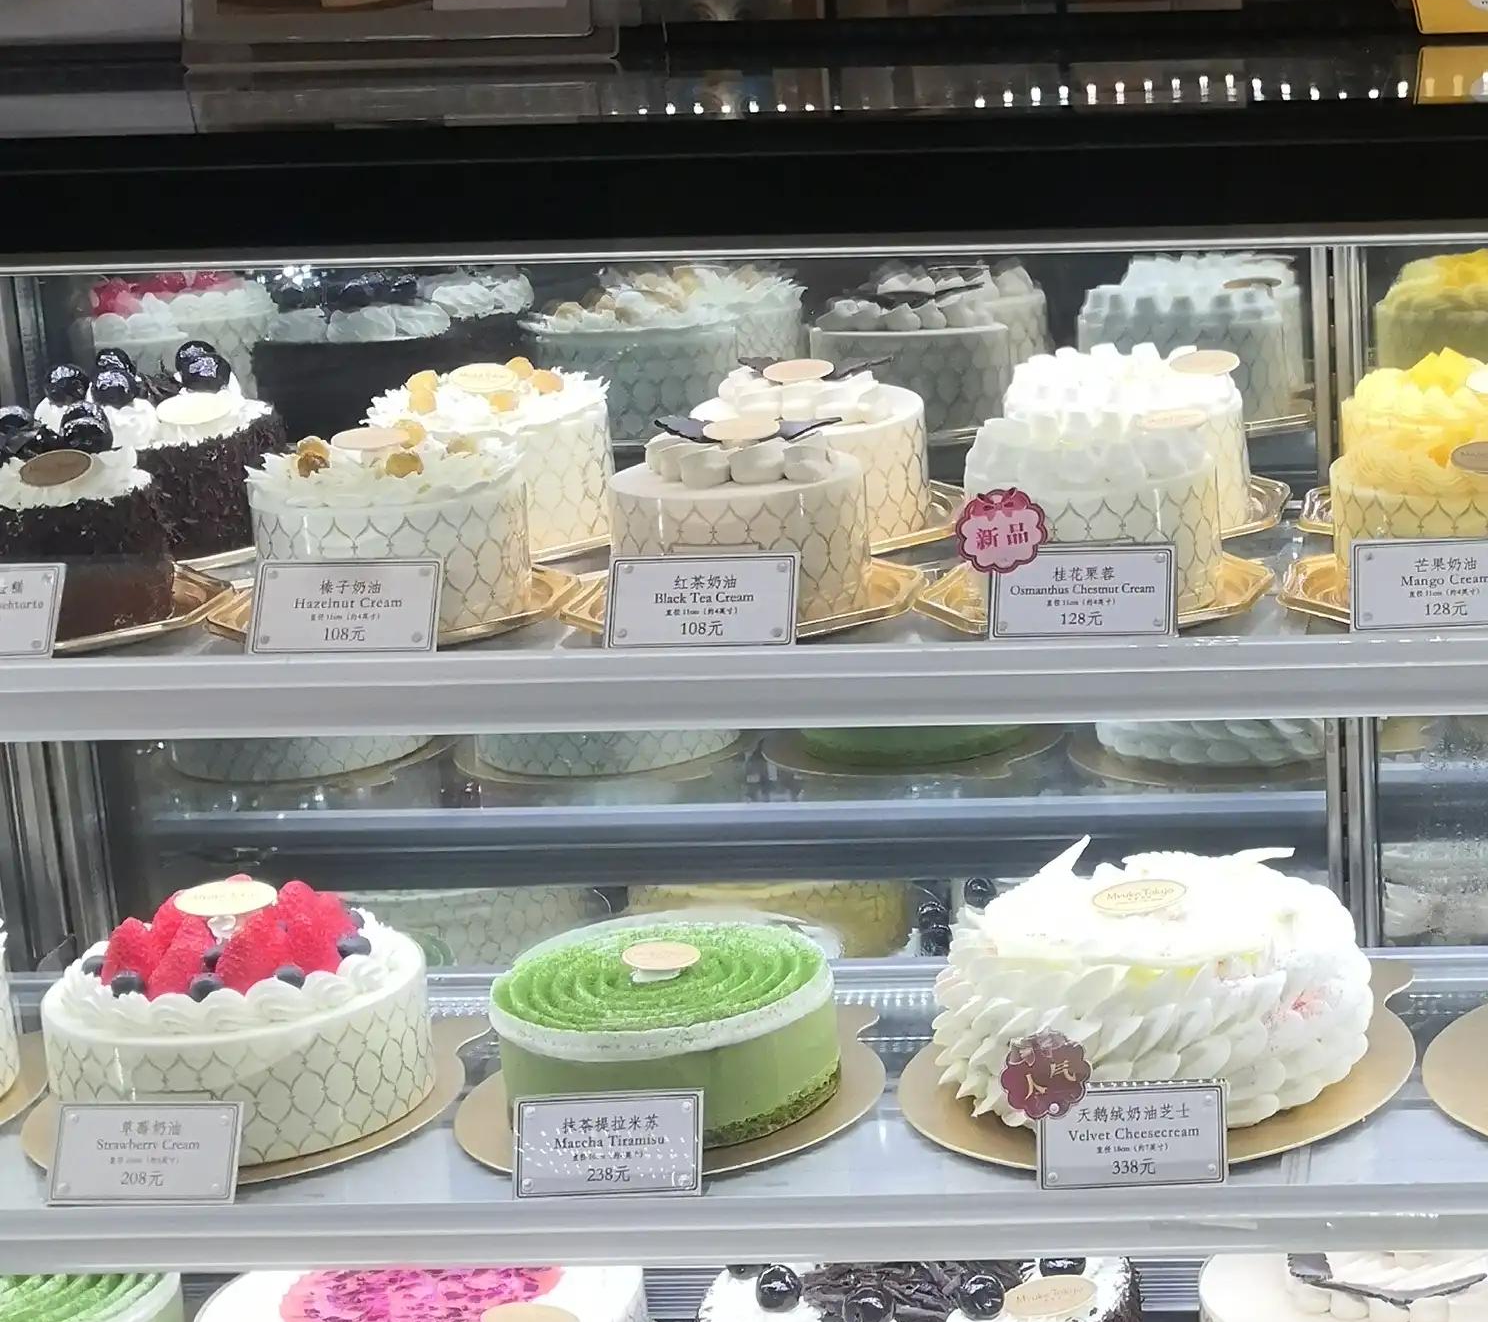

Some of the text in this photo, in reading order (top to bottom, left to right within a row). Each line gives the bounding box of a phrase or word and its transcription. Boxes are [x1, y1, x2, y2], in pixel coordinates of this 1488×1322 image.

[975, 521, 1030, 551] 新品
[1414, 557, 1477, 573] 芒果奶油
[320, 579, 381, 595] 榛子奶油
[673, 574, 737, 590] 红茶奶油
[1010, 582, 1155, 596] Osmanthus Chestnut Cream
[1401, 575, 1445, 589] Mango
[294, 596, 403, 610] Hazelnut Cream
[654, 591, 754, 604] Black Tea Cream
[1425, 601, 1468, 616] 128元
[1060, 611, 1103, 627] 128元
[323, 626, 366, 642] 108元
[680, 620, 724, 637] 108元
[1077, 1102, 1190, 1123] 天鹅绒奶油芝士
[120, 1120, 182, 1136] 草莓奶油
[1068, 1126, 1200, 1141] Velvet Cheesecream
[96, 1138, 200, 1151] Strawberry Cream
[553, 1134, 665, 1150] Maccha Tiramisu
[587, 1165, 631, 1183] 238元
[1112, 1157, 1156, 1175] 338元
[121, 1170, 164, 1187] 208元
